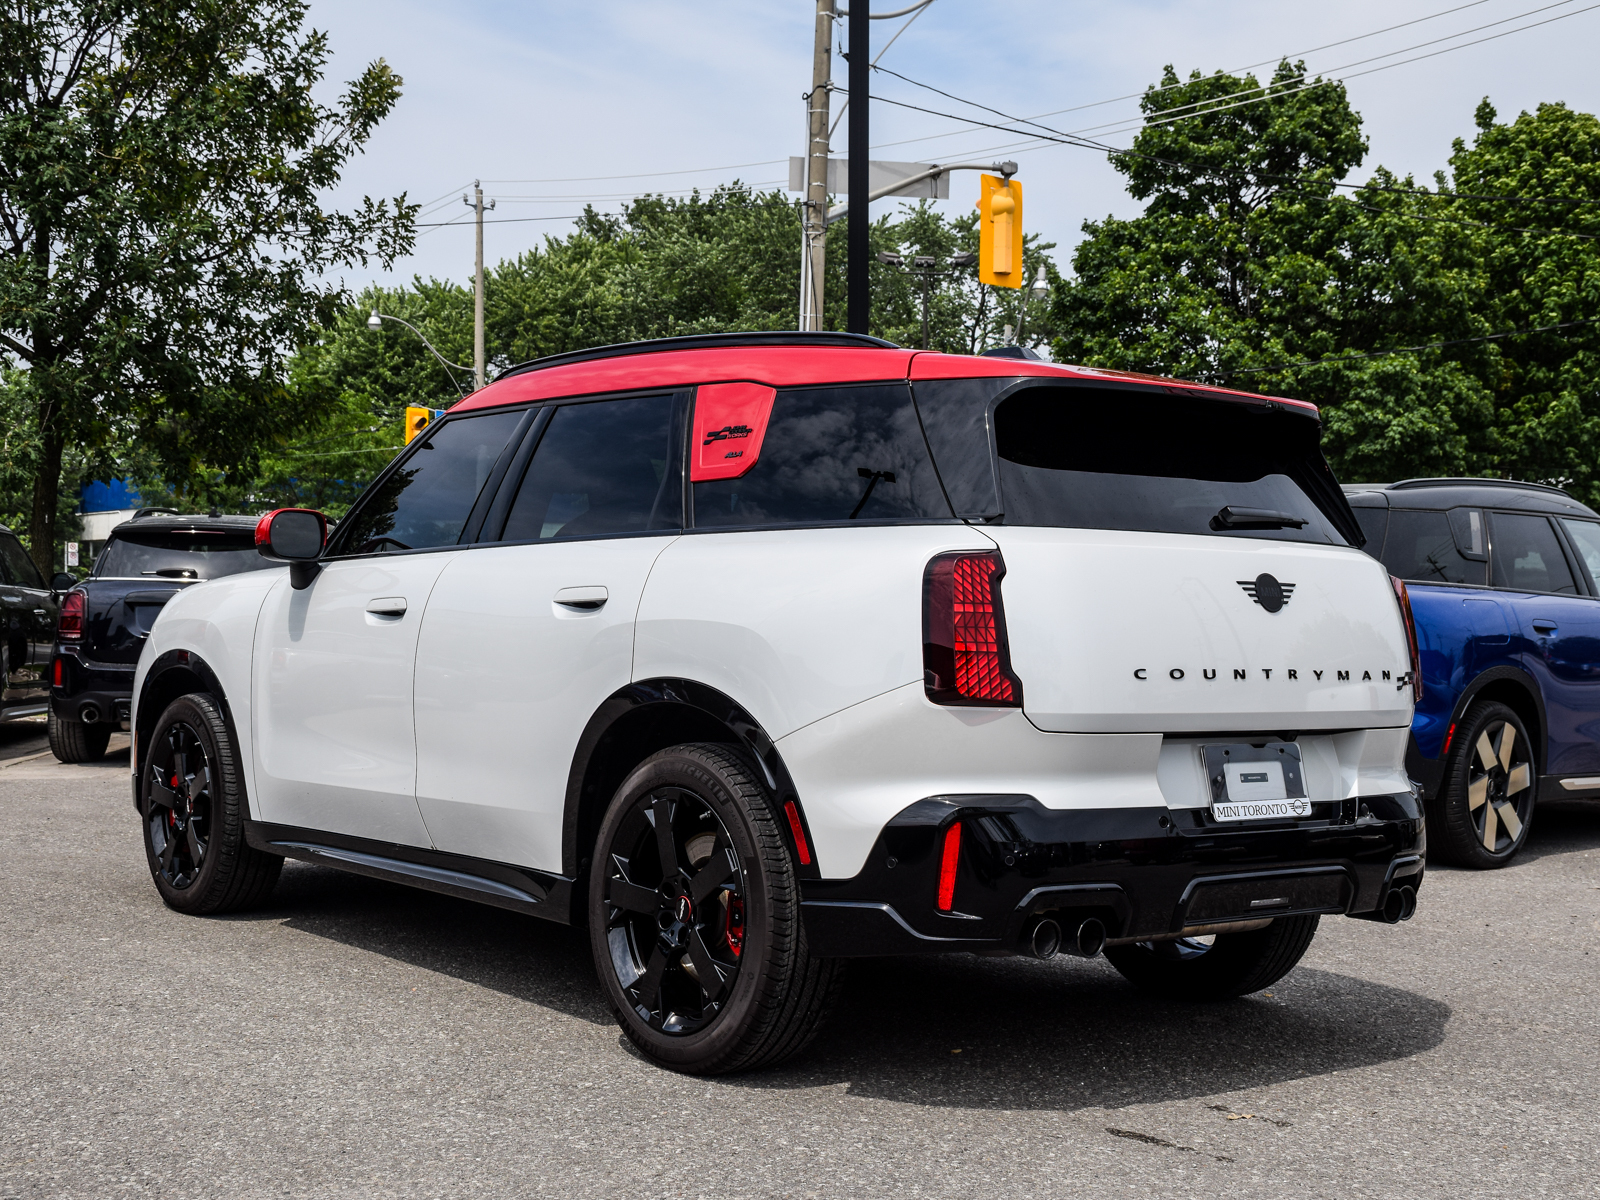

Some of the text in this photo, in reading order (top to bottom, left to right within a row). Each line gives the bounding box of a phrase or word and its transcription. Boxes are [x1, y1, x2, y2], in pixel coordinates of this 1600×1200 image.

[724, 450, 743, 458] ALL4
[1260, 586, 1281, 597] MINI
[1133, 668, 1391, 681] COUNTRYMAN
[676, 762, 728, 804] MICHELIN
[1216, 803, 1288, 818] MINI TORONTO
